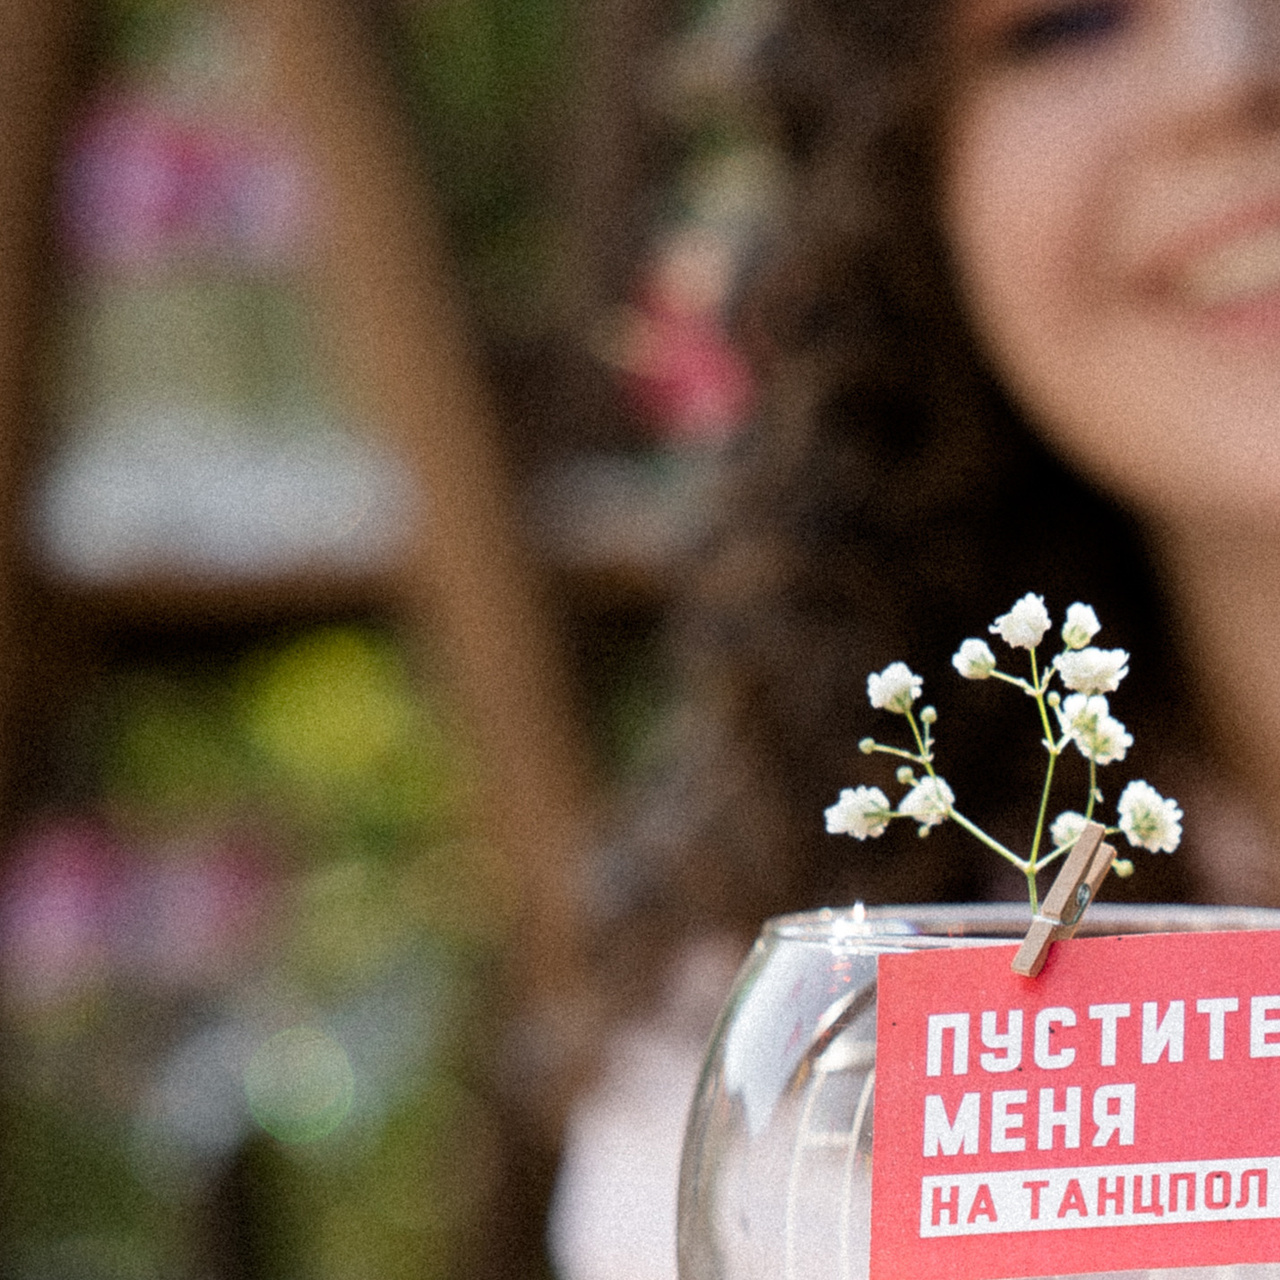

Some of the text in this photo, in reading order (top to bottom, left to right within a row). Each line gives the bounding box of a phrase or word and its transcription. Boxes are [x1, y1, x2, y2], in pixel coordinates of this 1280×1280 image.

[923, 1083, 1136, 1157] МЕНЯ
[930, 1168, 1269, 1227] НА ТАНЦПОЛ
